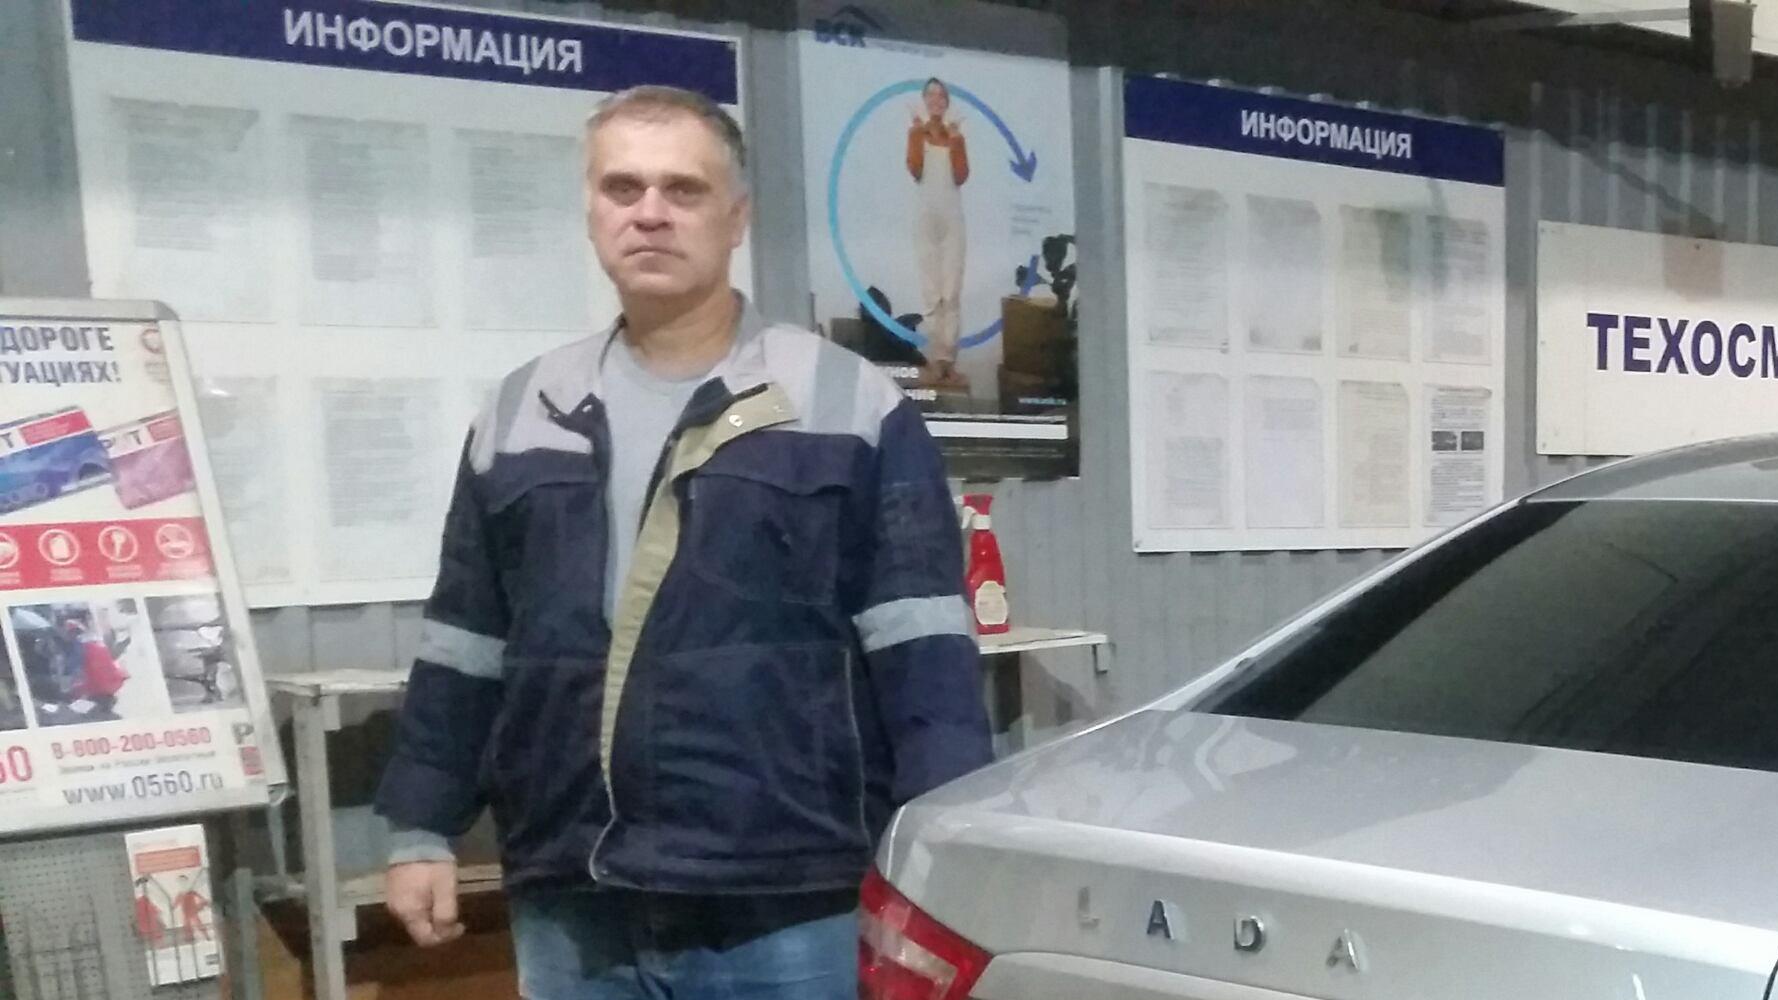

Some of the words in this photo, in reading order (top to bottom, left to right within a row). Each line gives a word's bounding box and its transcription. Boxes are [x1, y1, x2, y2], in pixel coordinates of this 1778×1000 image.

[283, 9, 584, 75] ИНФОРМАЦИЯ
[1240, 108, 1413, 159] ИНФОРМАЦИЯ
[52, 726, 212, 760] 8-800-200-0560
[62, 769, 224, 805] www.0560.ru
[1076, 885, 1368, 973] LADA
